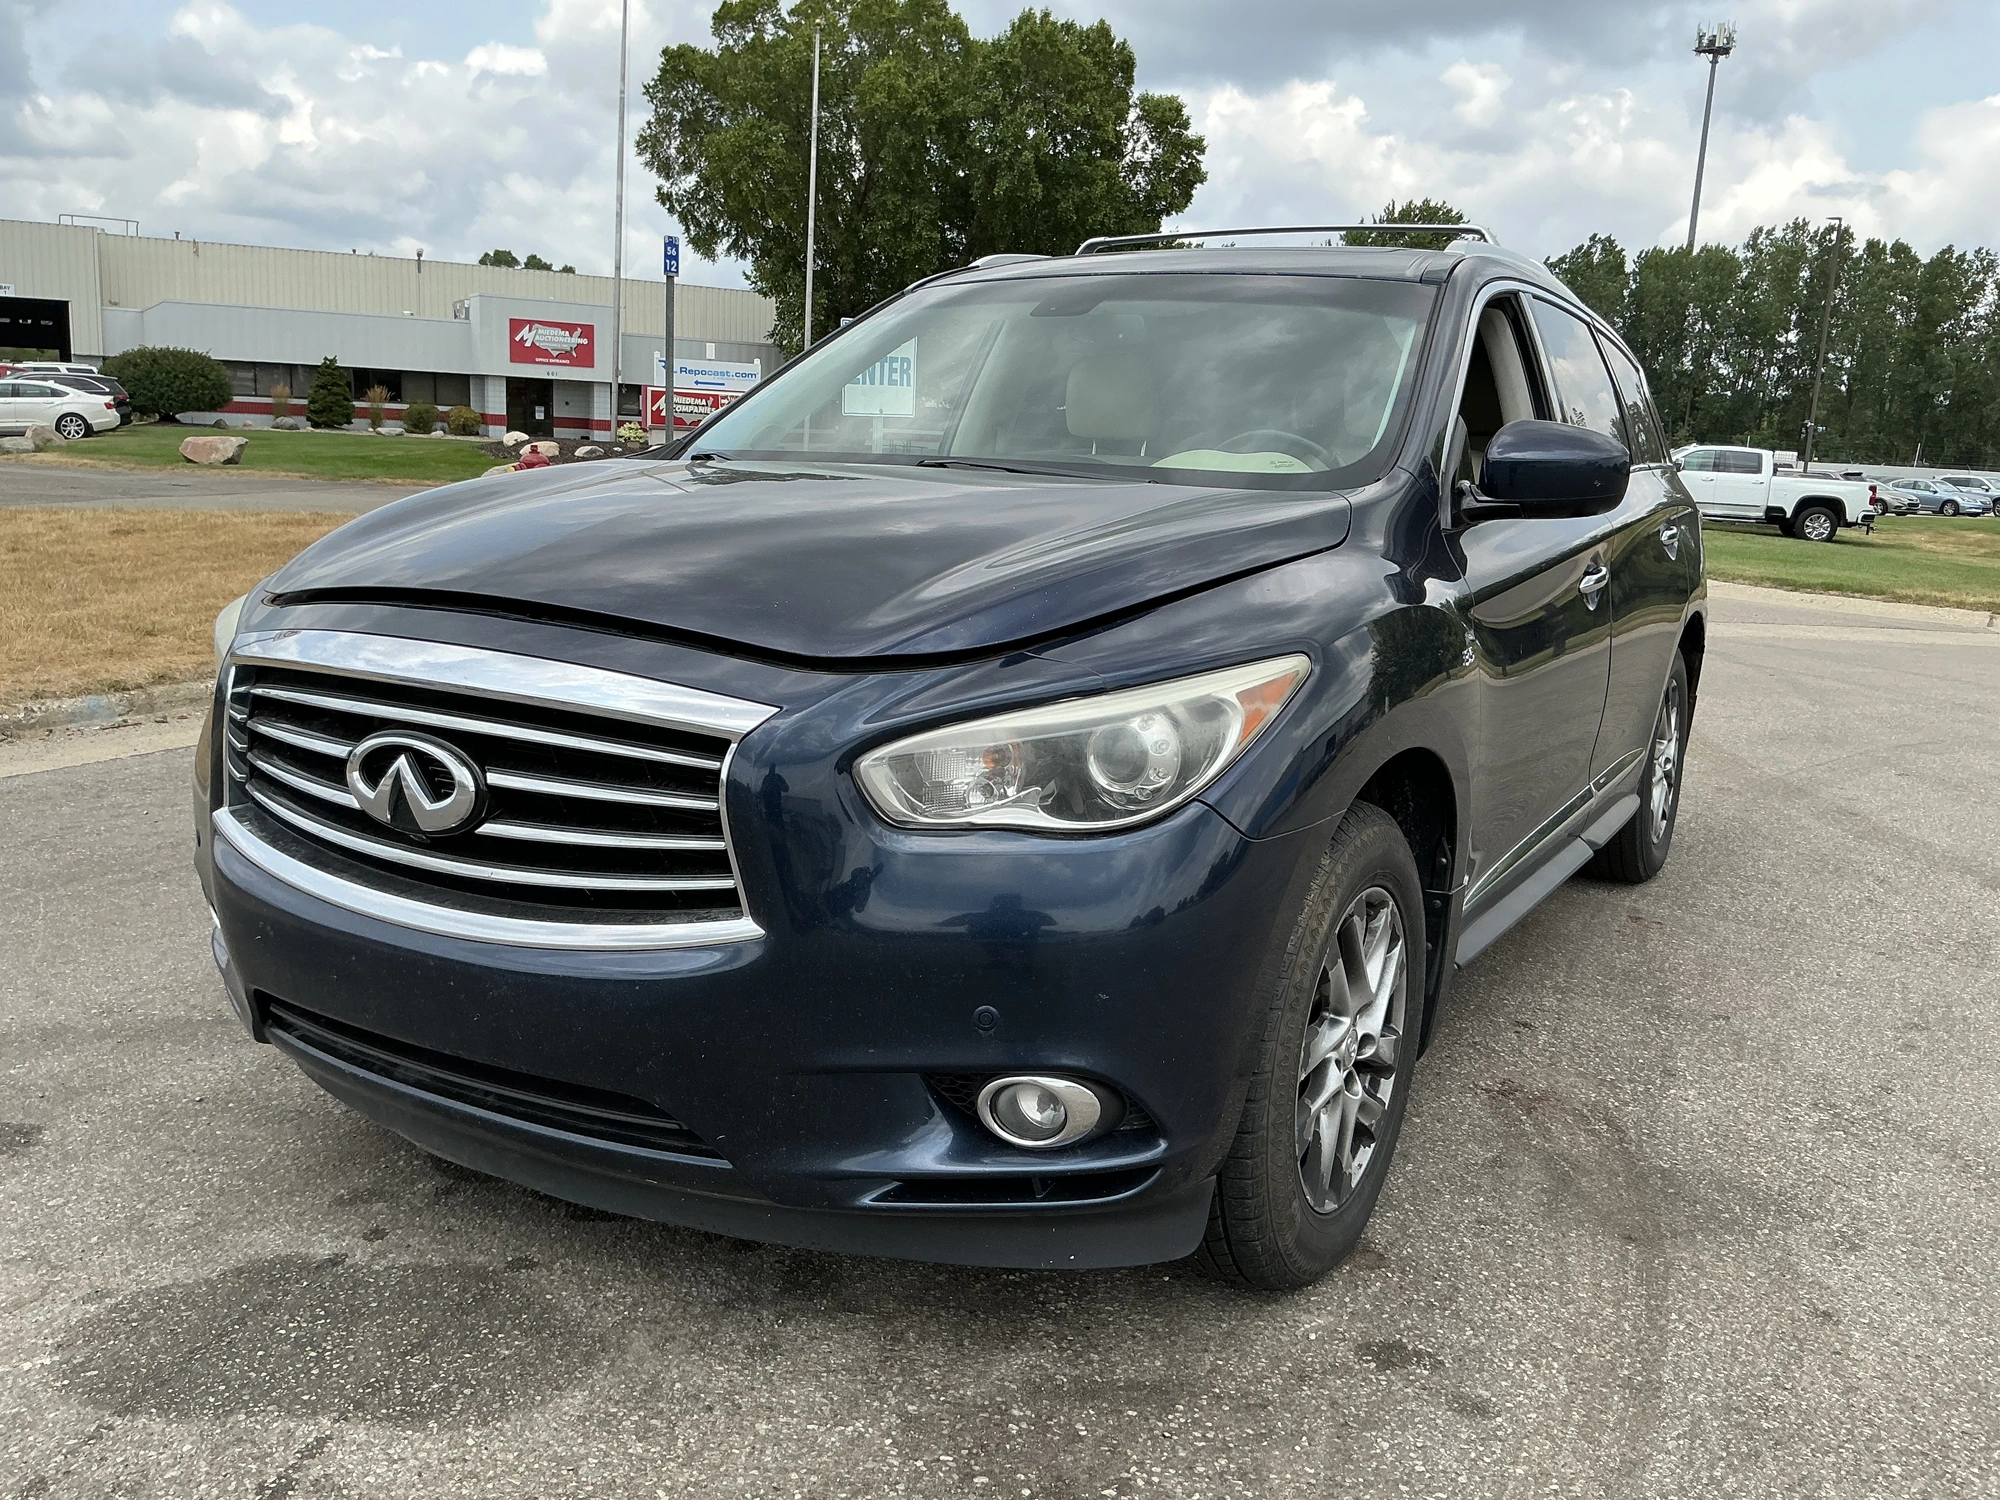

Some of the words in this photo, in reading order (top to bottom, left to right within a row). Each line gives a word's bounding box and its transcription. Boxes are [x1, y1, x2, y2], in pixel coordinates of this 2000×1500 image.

[666, 246, 677, 256] 56
[665, 259, 677, 272] 12
[537, 328, 570, 337] MIEDEMA
[534, 335, 589, 345] AUCTIONEERING
[679, 366, 757, 379] Repocast.com
[673, 396, 707, 406] MIEDEMA
